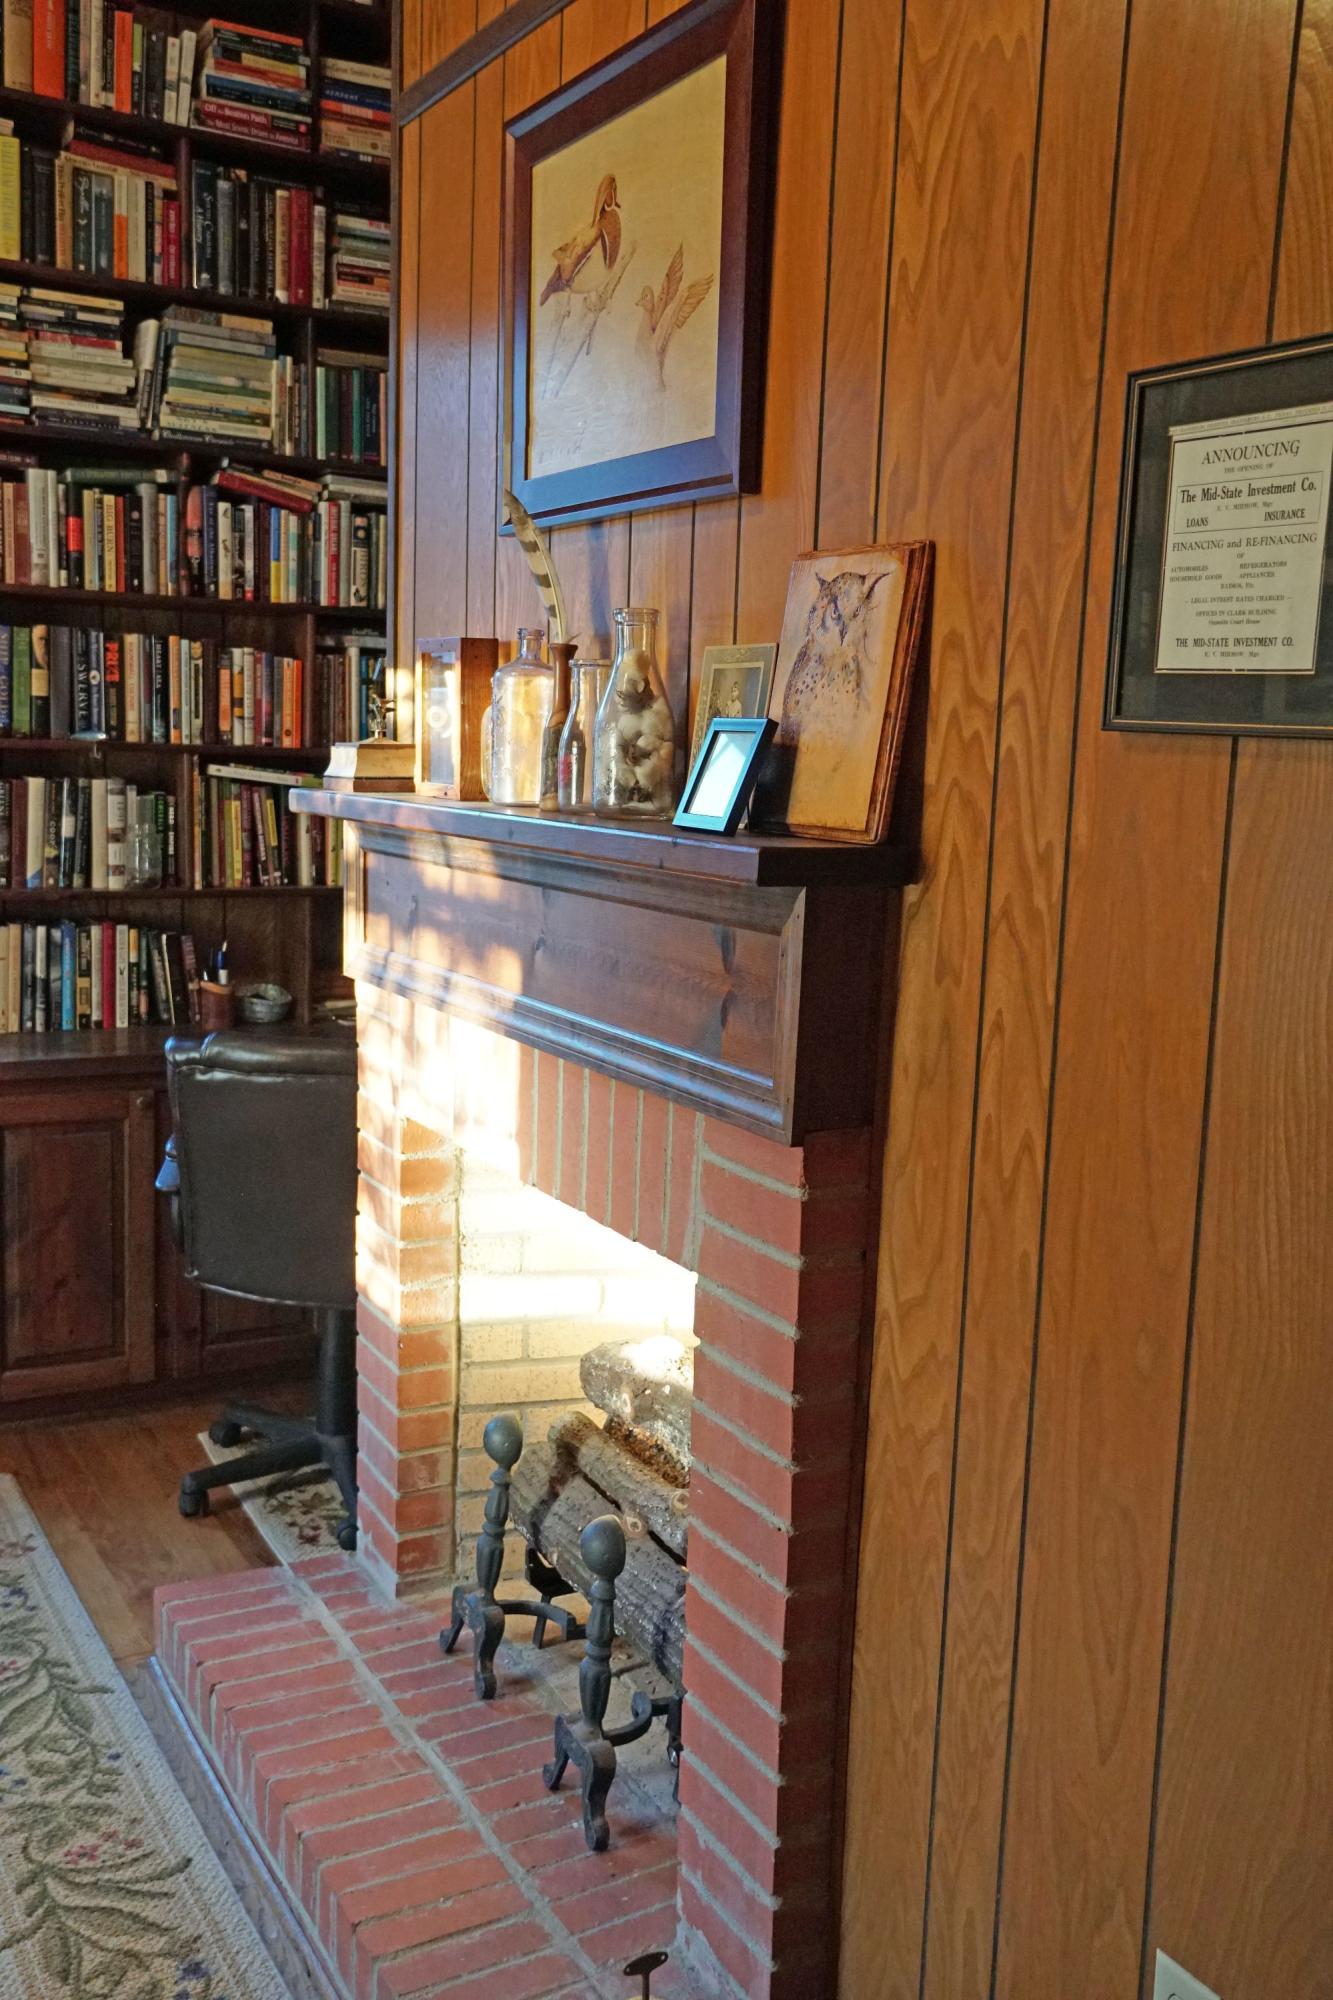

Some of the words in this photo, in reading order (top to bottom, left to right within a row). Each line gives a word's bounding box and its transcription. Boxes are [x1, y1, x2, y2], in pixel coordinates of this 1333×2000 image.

[1201, 439, 1301, 465] ANNOUNCING
[1180, 489, 1197, 504] The
[1200, 483, 1243, 502] Mid-State
[1247, 480, 1296, 498] Investment
[1301, 477, 1317, 493] Co.
[106, 503, 114, 522] BIG
[1186, 517, 1209, 528] LOANS
[1264, 508, 1306, 522] INSURANCE
[106, 525, 115, 553] BURN
[1172, 539, 1224, 552] FINANCING
[1226, 537, 1243, 549] and
[1245, 533, 1318, 548] RE-FINANCING
[1175, 638, 1189, 648] THE
[1193, 637, 1229, 648] MID-STATE
[1233, 637, 1278, 648] INVESTMENT
[1281, 636, 1294, 647] CO.
[105, 641, 120, 682] PRIZE
[77, 663, 89, 718] SWERVE
